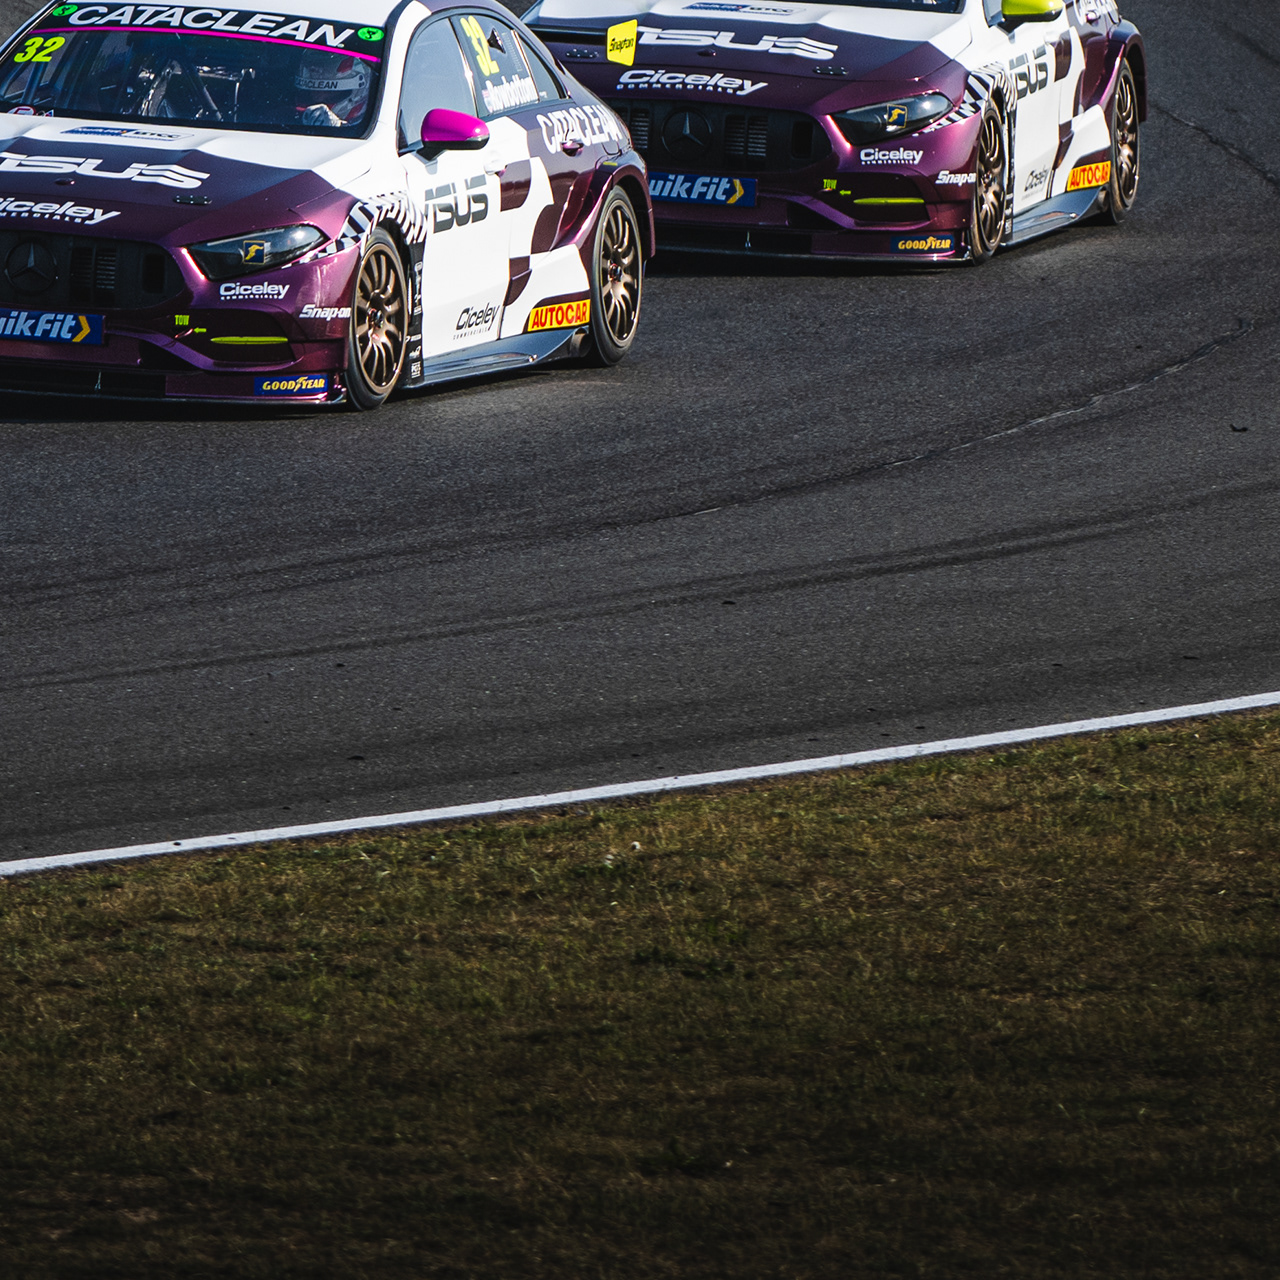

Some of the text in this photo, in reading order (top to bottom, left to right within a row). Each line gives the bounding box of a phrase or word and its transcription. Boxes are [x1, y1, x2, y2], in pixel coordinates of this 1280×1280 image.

[68, 5, 353, 48] CATACLEAN
[13, 36, 66, 63] 32
[460, 15, 500, 77] 32
[609, 37, 634, 53] Snap-on
[616, 83, 734, 95] COMMERCIALS
[619, 69, 768, 96] Ciceley
[860, 146, 924, 165] Ciceley
[648, 174, 730, 201] wikFit
[823, 179, 838, 190] TOW
[425, 173, 488, 234] ASUS
[898, 235, 952, 251] GOODYEAR
[219, 281, 290, 299] Ciceley
[174, 314, 190, 326] TOW
[299, 303, 352, 321] Snap-on
[456, 302, 501, 332] Ciceley
[531, 302, 588, 329] AUTOCAR
[262, 376, 325, 392] GOODYEAR
